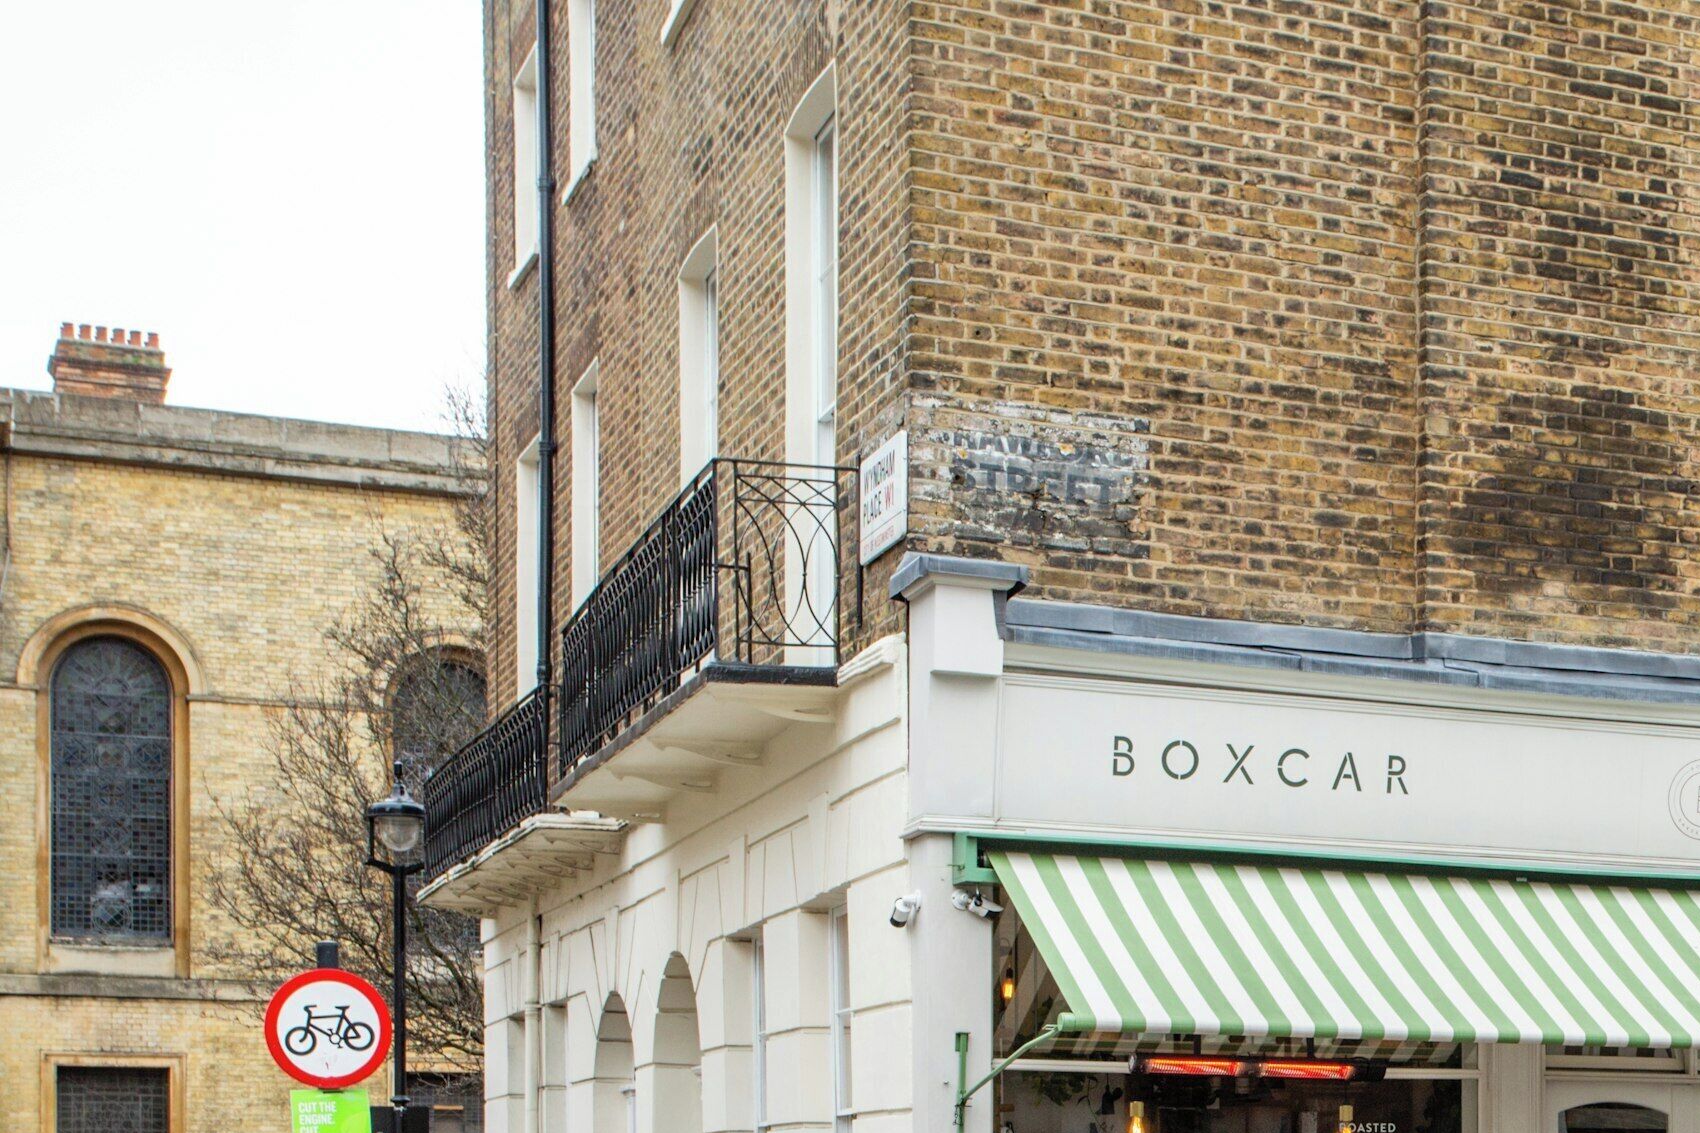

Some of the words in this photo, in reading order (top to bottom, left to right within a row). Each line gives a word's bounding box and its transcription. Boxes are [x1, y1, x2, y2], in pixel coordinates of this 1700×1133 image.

[863, 490, 881, 528] PLACE
[1112, 735, 1409, 795] BOXCAR
[298, 1102, 317, 1113] CUT
[319, 1101, 336, 1113] THE
